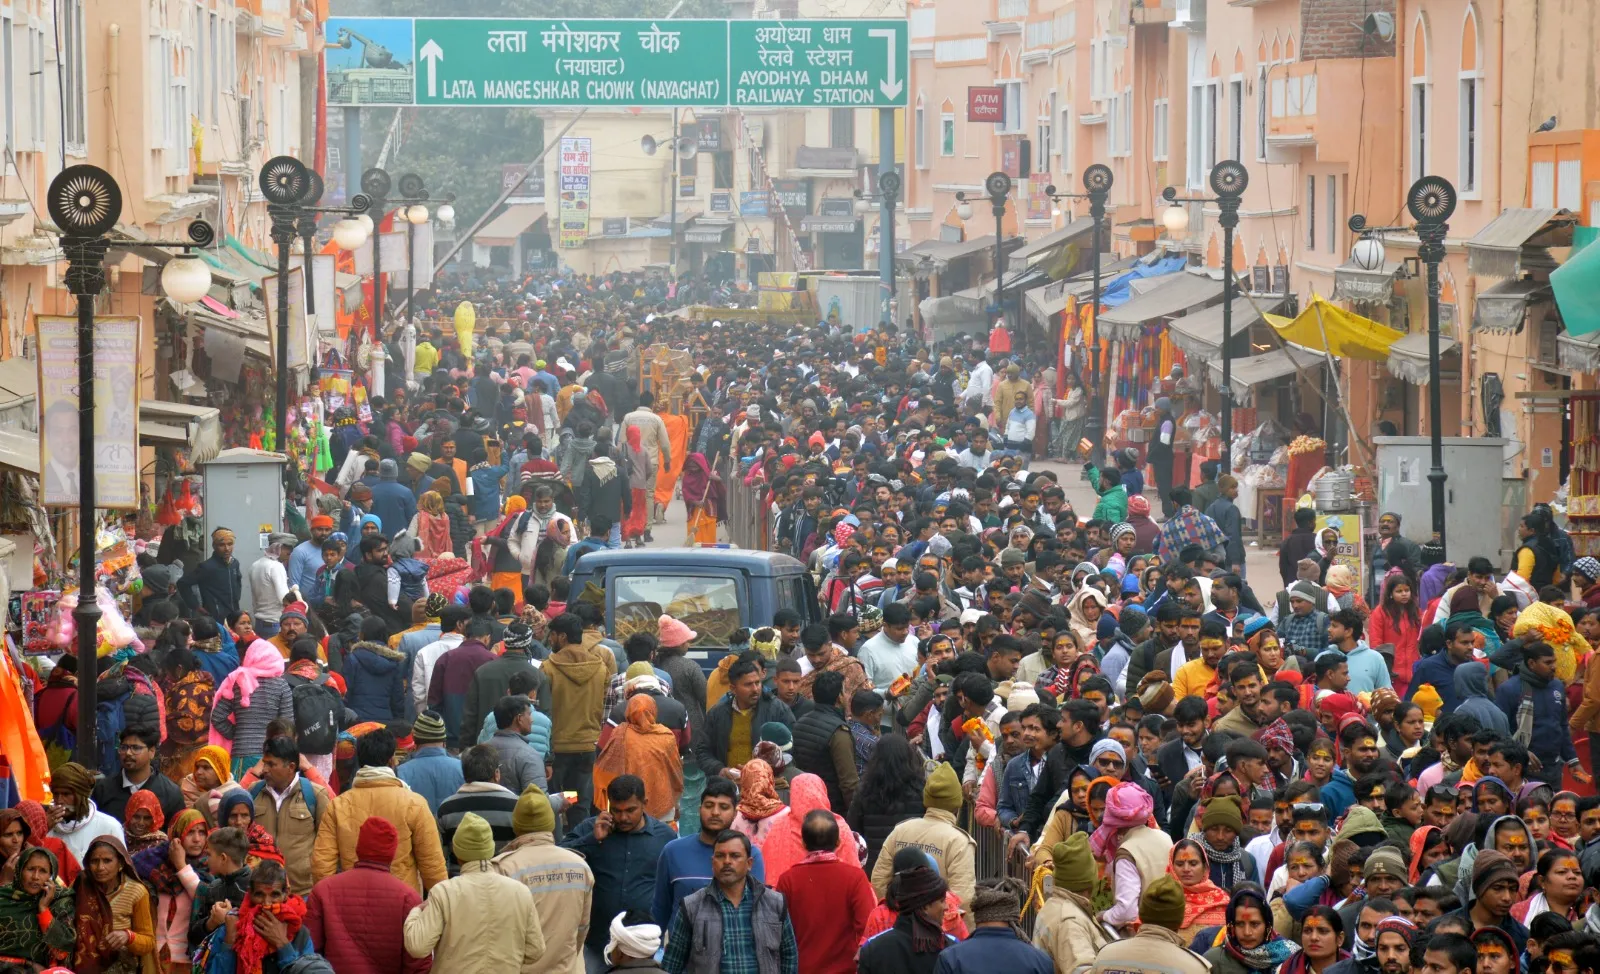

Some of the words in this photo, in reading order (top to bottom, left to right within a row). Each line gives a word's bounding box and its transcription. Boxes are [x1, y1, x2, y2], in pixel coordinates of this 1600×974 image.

[487, 30, 527, 53] लता
[540, 22, 621, 53] मंगेशकर
[638, 22, 681, 53] चौक
[755, 22, 811, 44] अयोध्या
[822, 27, 852, 44] धाम
[758, 44, 794, 66] रेलवे
[805, 44, 853, 66] स्टेशन
[555, 58, 625, 76] (नयाघाट)
[738, 70, 811, 85] AYODHYA
[821, 70, 868, 85] DHAM
[443, 80, 476, 99] LATA
[484, 80, 580, 99] MANGESHKAR
[586, 81, 634, 99] CHOWK
[640, 78, 720, 100] (NAYAGHAT)
[736, 88, 804, 103] RAILWAY
[813, 88, 874, 103] STATION
[974, 94, 999, 104] ATM
[974, 104, 998, 115] एटीएम
